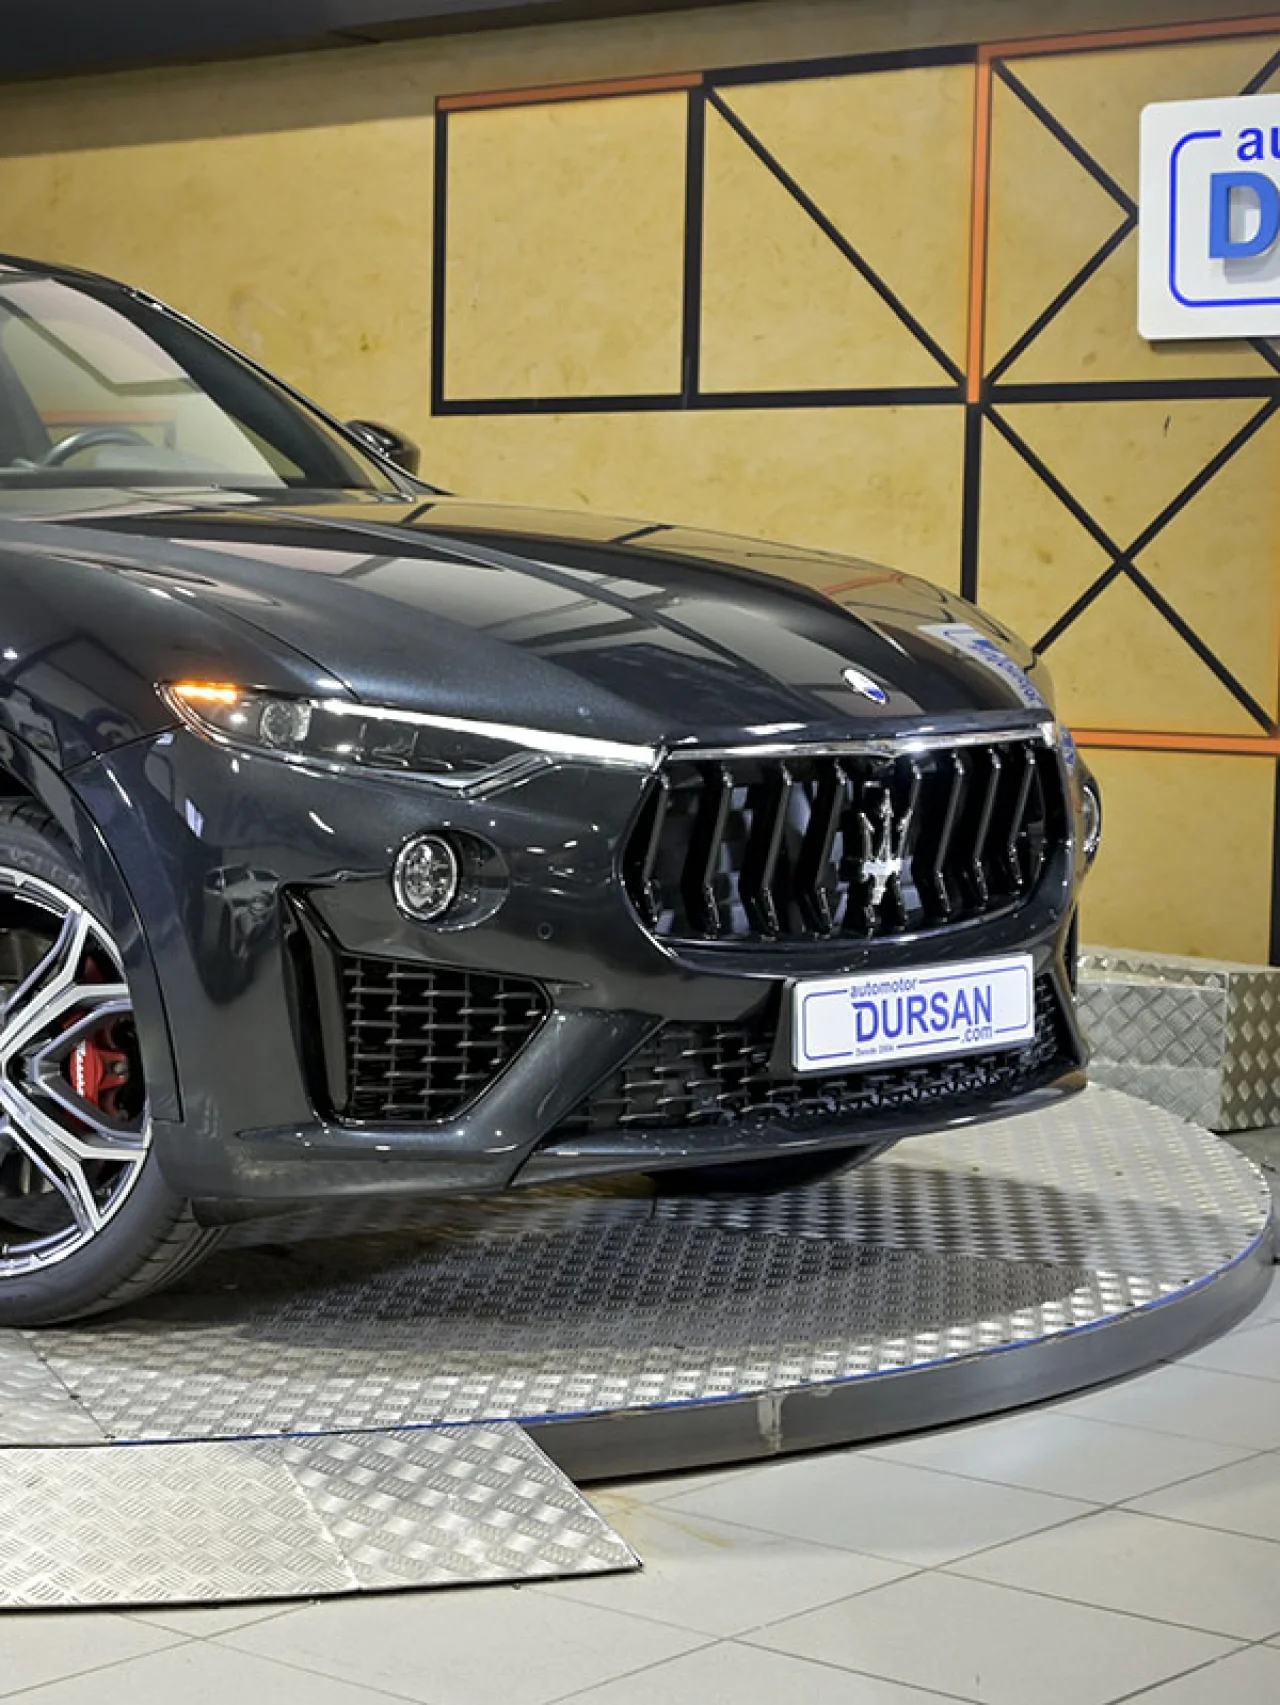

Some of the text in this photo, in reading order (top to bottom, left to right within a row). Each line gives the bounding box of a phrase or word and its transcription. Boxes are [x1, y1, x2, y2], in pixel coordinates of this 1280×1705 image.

[850, 976, 917, 999] automotor
[851, 984, 993, 1043] DURSAN
[961, 1026, 993, 1043] .com
